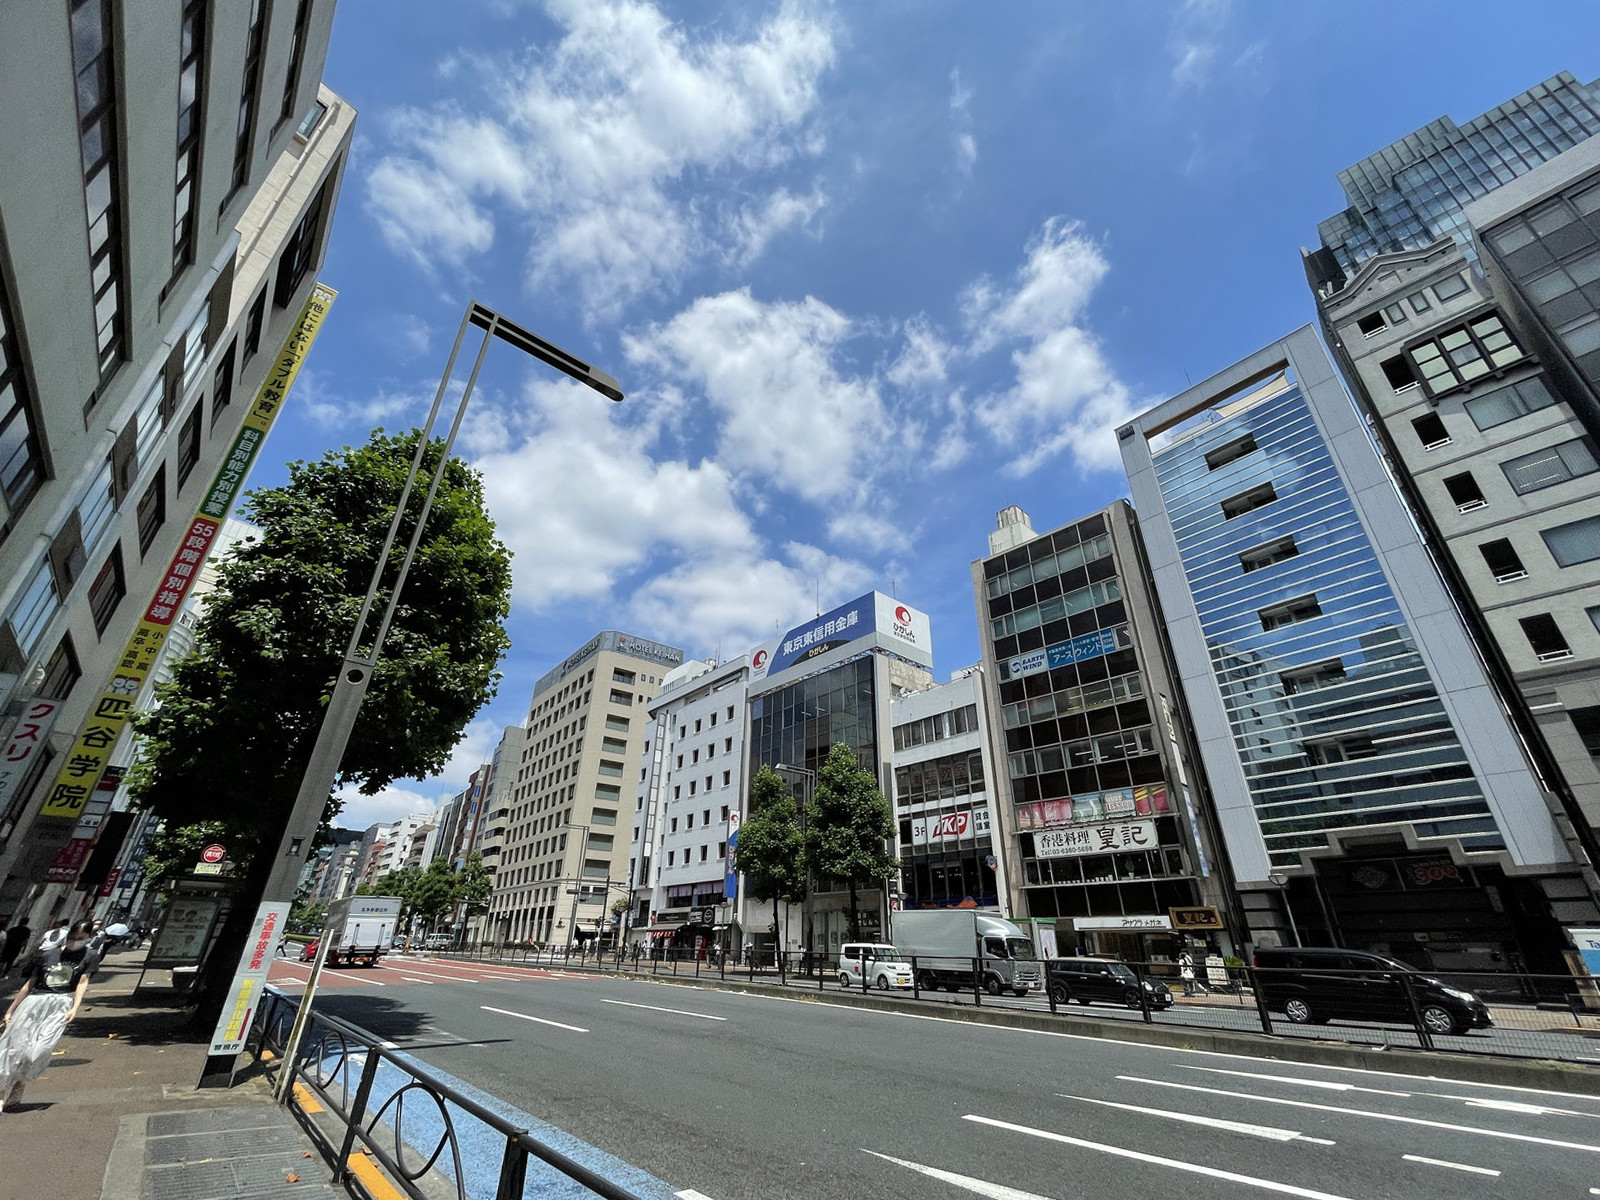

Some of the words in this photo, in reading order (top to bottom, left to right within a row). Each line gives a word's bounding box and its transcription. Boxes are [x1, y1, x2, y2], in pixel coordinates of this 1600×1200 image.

[205, 429, 259, 515] 科目別能力別授業
[150, 523, 215, 620] 55段階個別指導
[783, 610, 858, 656] 東京東信用金庫
[629, 642, 652, 654] HOTEL
[653, 649, 680, 663] KEIHAN
[1022, 653, 1045, 665] EARTH
[1022, 661, 1042, 671] WIND
[7, 704, 55, 762] クスリ
[48, 698, 131, 809] 四谷学院
[914, 826, 926, 837] 3F
[1041, 830, 1090, 849] 香港料理
[1096, 826, 1148, 850] 皇記
[248, 912, 278, 970] 交通事故多発
